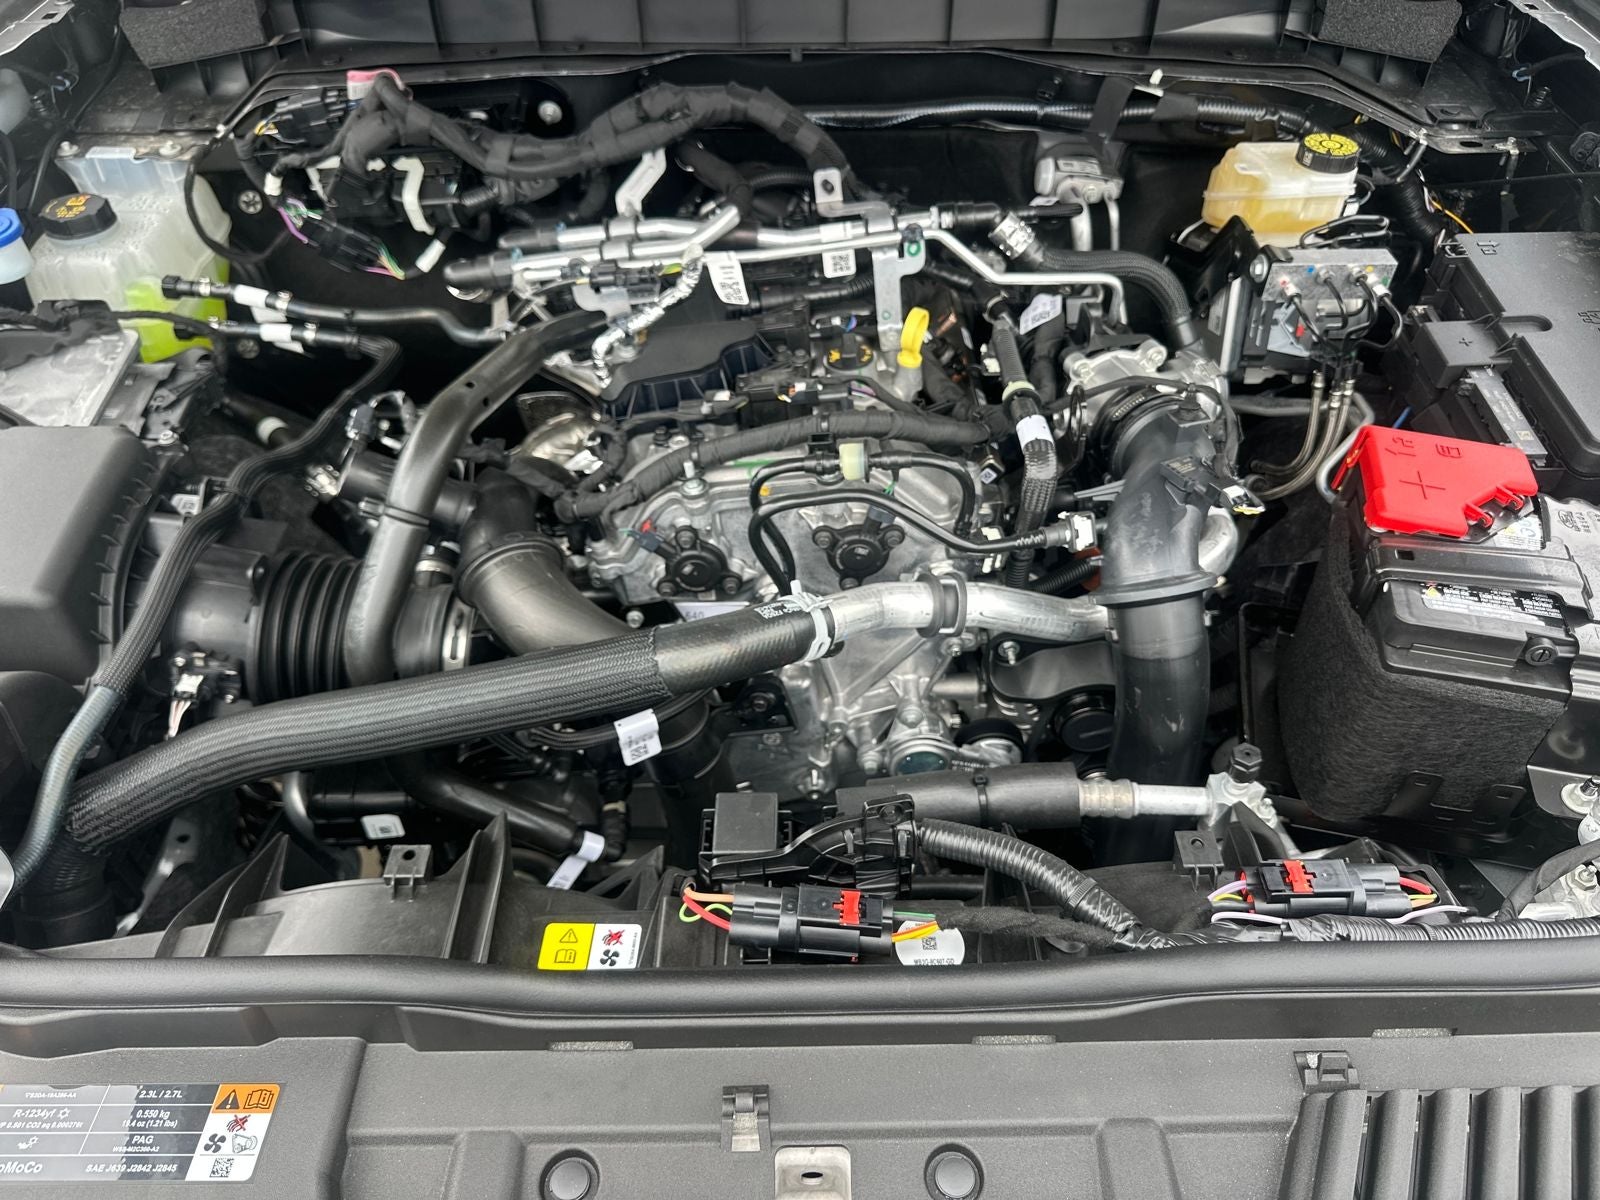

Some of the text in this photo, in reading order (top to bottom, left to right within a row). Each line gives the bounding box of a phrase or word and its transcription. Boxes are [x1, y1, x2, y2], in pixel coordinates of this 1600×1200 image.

[138, 1090, 183, 1098] 2.3L / 2.7L
[12, 1108, 57, 1120] R-1234yf
[136, 1109, 171, 1120] 0.550 kg
[163, 1119, 178, 1128] lbs)
[131, 1135, 154, 1145] PAG
[85, 1164, 178, 1173] SAE J639 J2842 J2845
